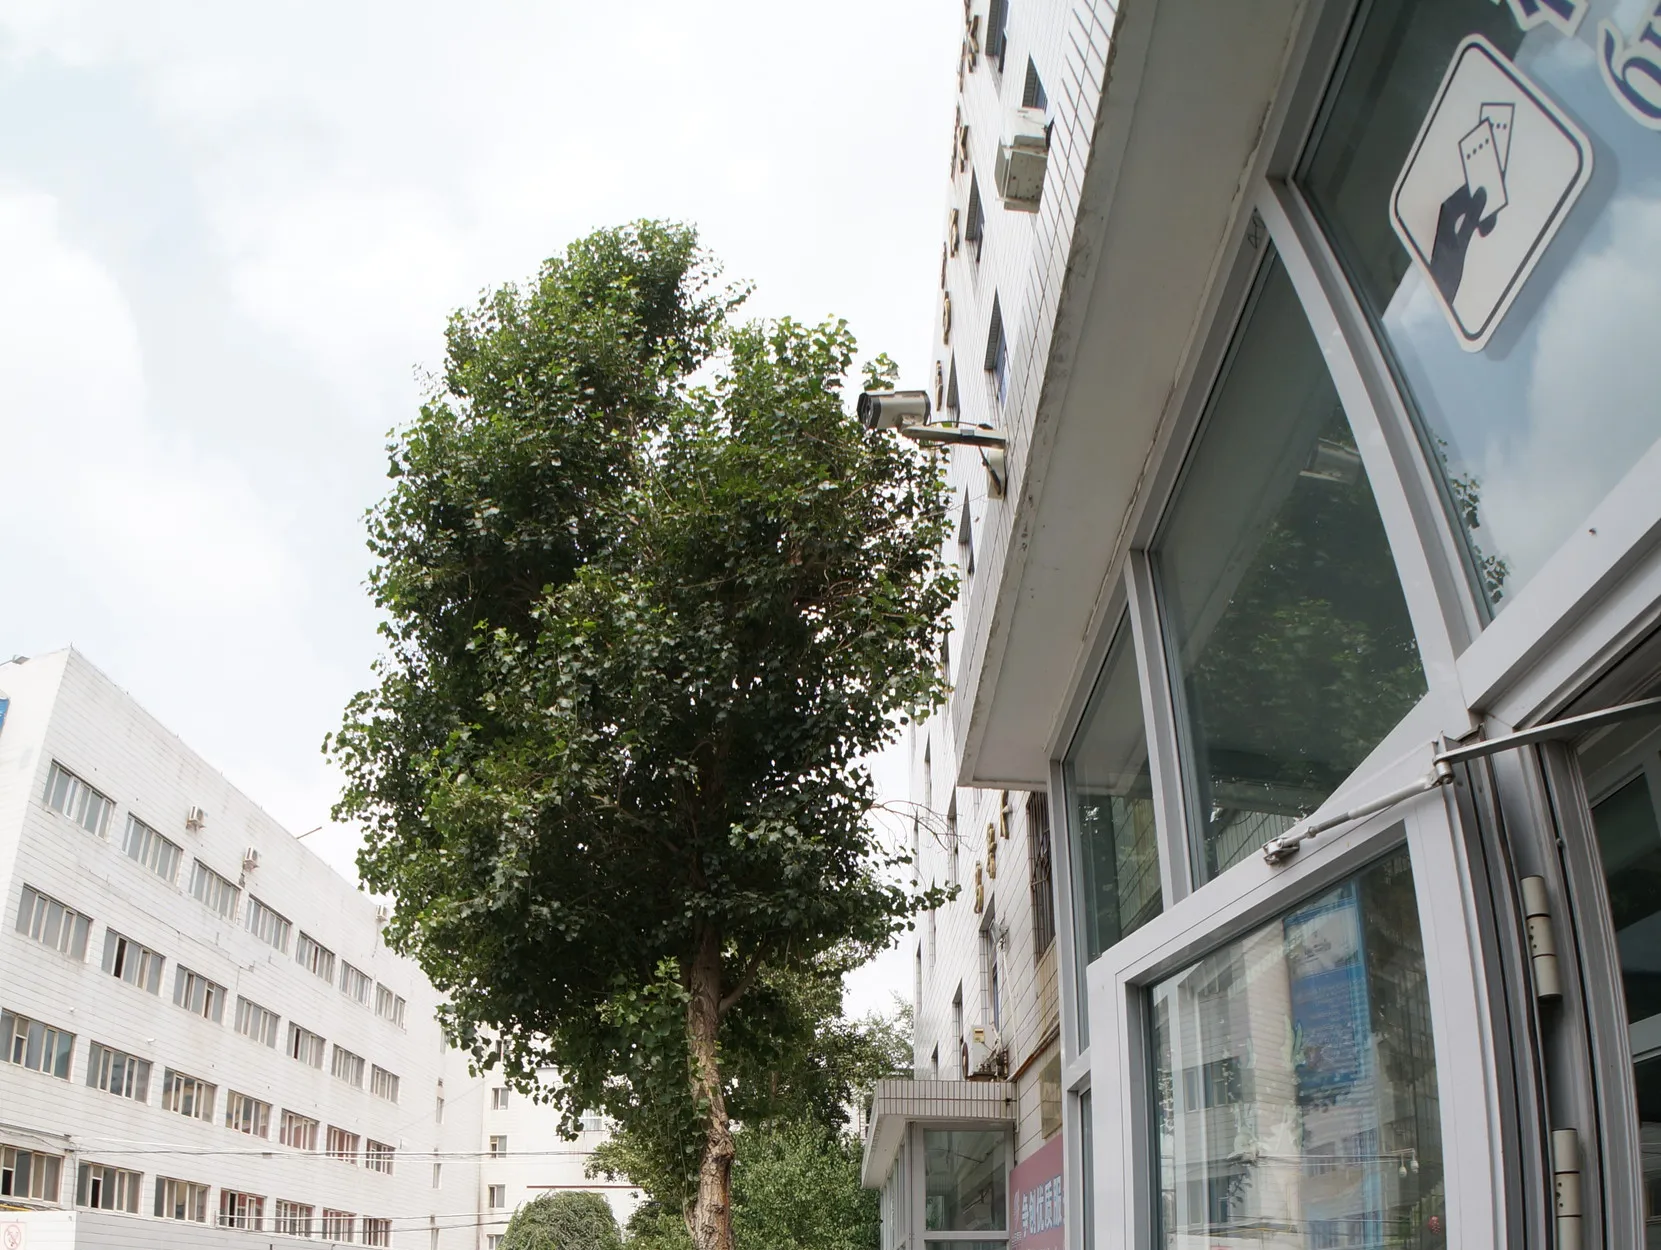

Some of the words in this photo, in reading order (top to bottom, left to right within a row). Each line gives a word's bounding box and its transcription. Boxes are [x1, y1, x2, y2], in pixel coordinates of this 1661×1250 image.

[1022, 1175, 1066, 1238] 争创优质服
